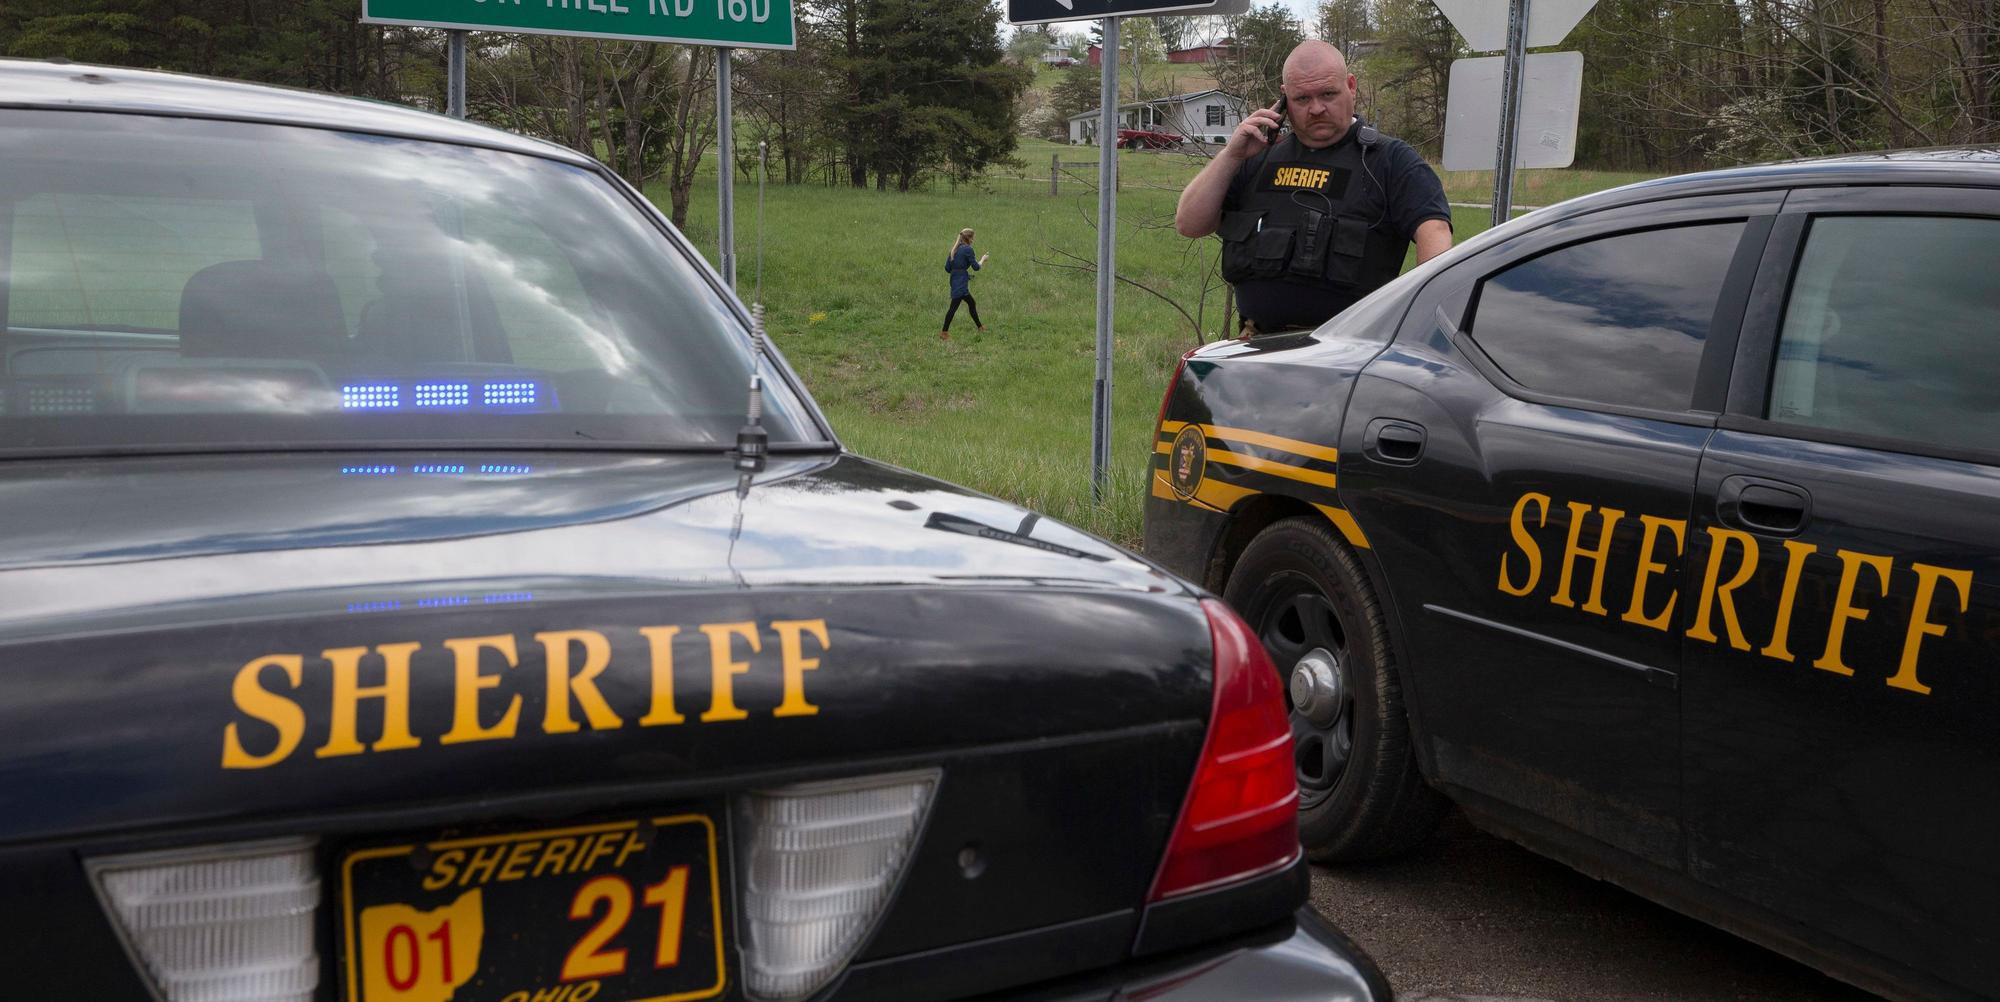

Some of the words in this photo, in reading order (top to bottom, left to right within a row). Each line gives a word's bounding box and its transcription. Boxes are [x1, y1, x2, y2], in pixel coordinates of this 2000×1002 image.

[1274, 167, 1330, 189] SHERIFF
[1497, 491, 1974, 695] SHERIFF
[221, 619, 831, 769] SHERIFF
[423, 831, 648, 890] SHERIFF
[383, 919, 455, 992] 01
[559, 864, 691, 982] 21
